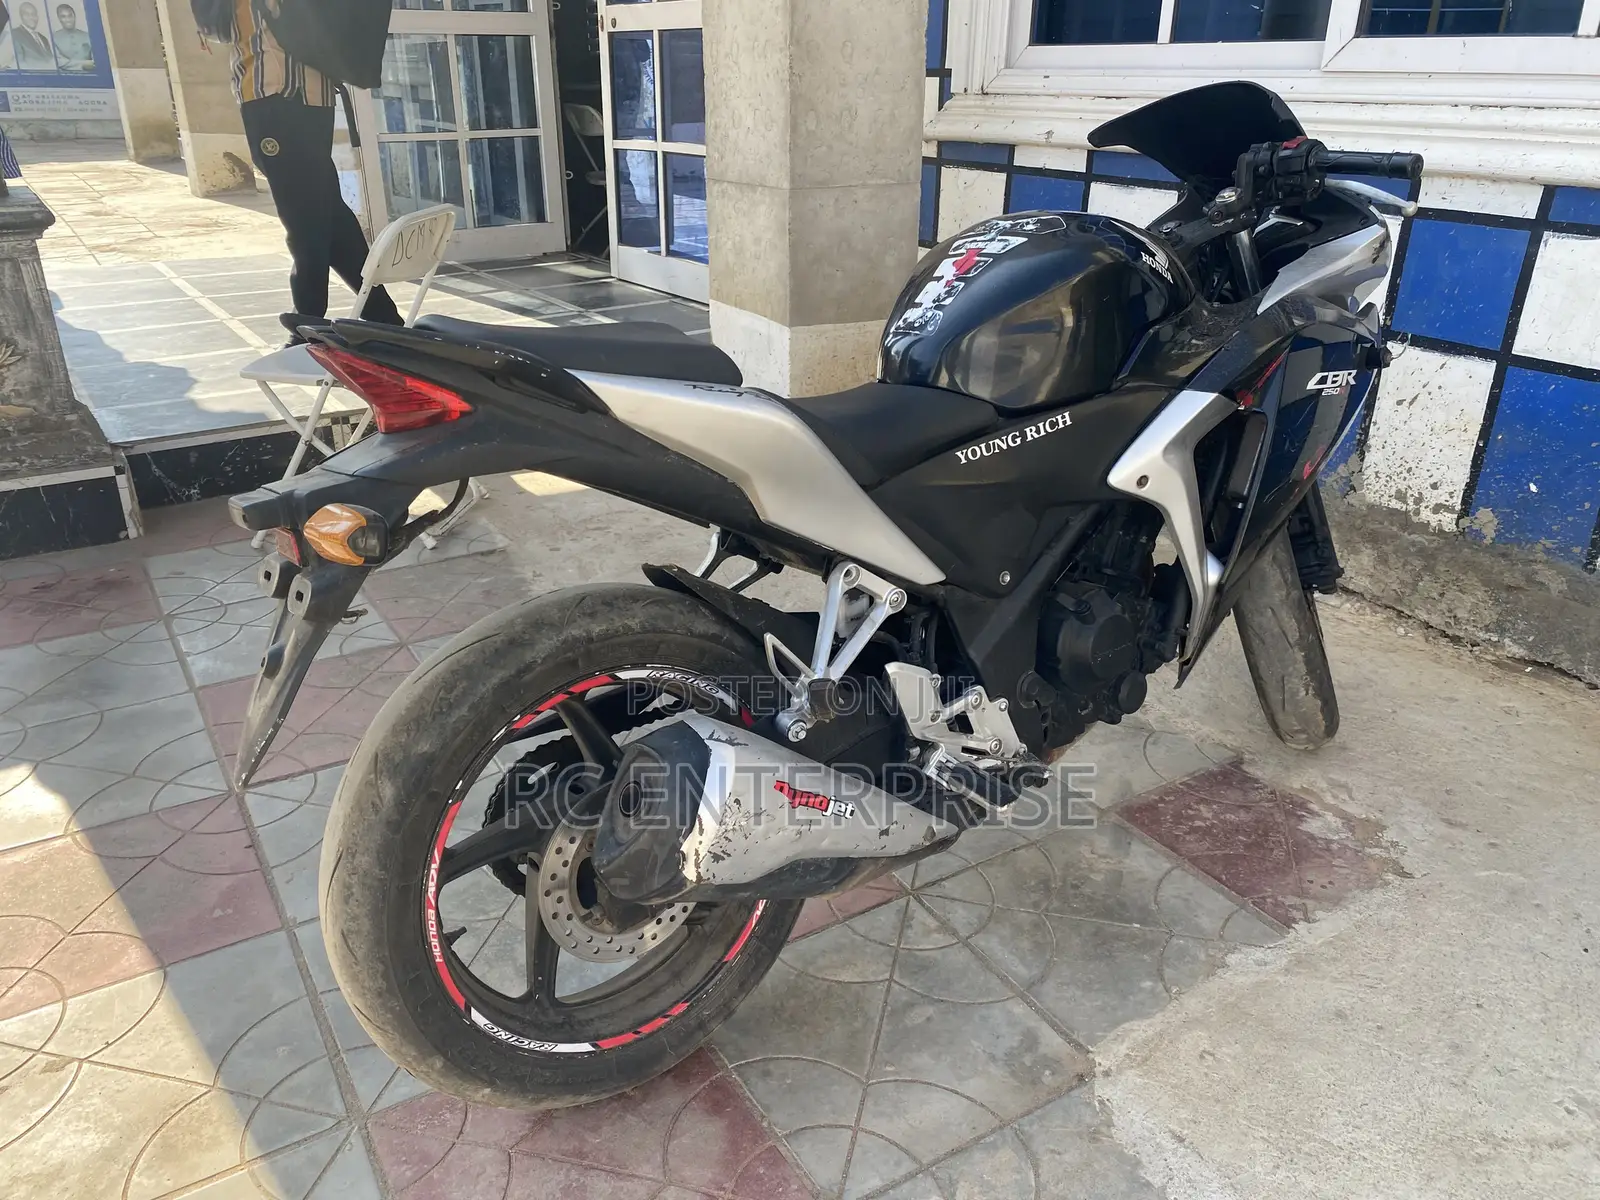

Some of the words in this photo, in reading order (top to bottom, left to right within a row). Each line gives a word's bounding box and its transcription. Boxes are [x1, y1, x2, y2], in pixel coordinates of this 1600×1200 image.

[1140, 251, 1174, 284] HONDA
[1306, 369, 1358, 390] CBR
[955, 431, 1022, 464] YOUNG
[1024, 411, 1073, 442] RICH
[647, 669, 720, 695] RACING
[427, 847, 440, 907] ADV
[483, 1022, 559, 1053] RACING
